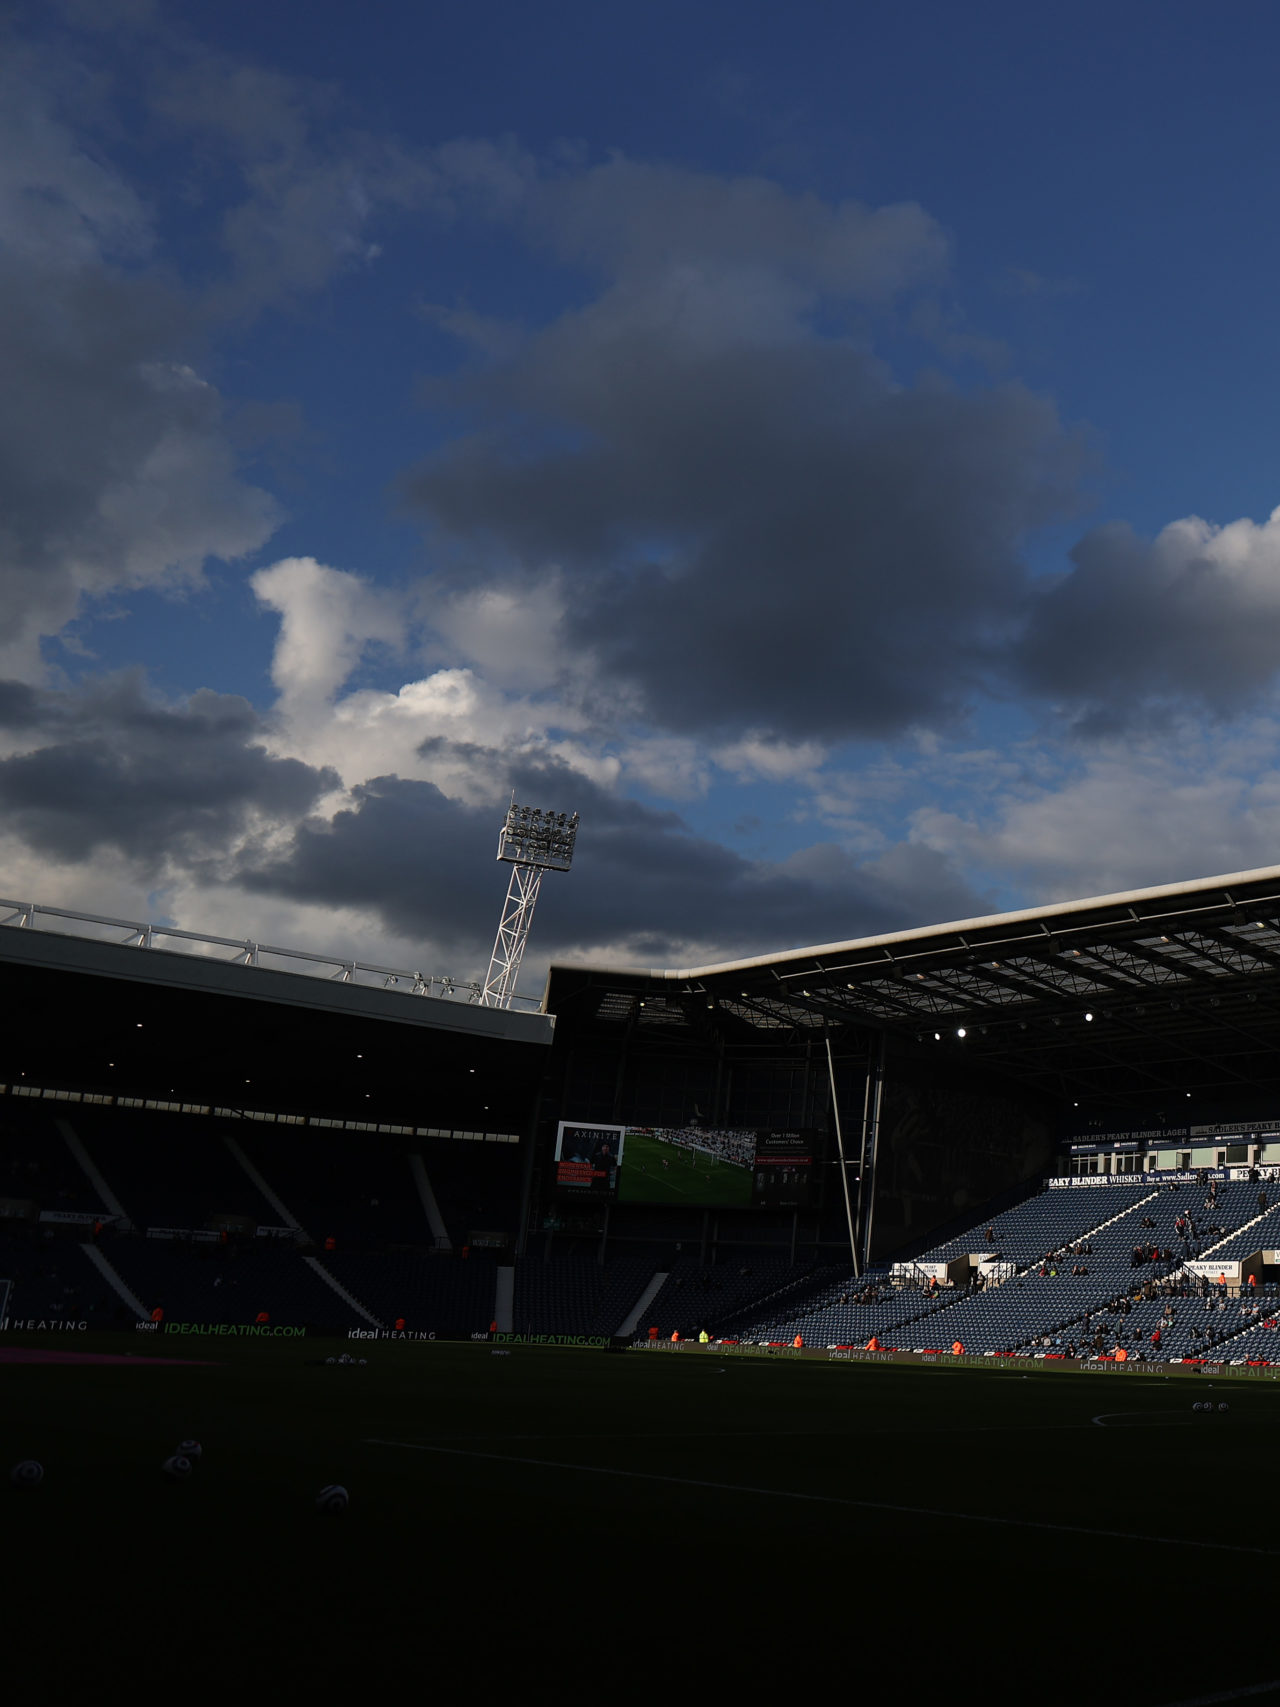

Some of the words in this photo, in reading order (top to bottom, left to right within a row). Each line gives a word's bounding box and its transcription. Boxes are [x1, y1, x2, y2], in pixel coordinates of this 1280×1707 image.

[1208, 1124, 1245, 1133] SADLER'S
[1247, 1122, 1272, 1131] PEAKY
[1074, 1134, 1106, 1142] SADLER'S
[1107, 1132, 1130, 1140] PEAKY
[1132, 1130, 1161, 1139] BLINDER
[1237, 1168, 1268, 1178] PEKY
[1042, 1177, 1070, 1186] PEAKY
[1072, 1176, 1108, 1185] BLINDER
[1110, 1174, 1142, 1183] WHISKEY
[14, 1320, 88, 1331] HEATING
[136, 1320, 158, 1330] ideal
[164, 1322, 306, 1336] IDEALHEATING.COM
[348, 1328, 379, 1339] ideal
[382, 1331, 436, 1340] HEATING
[471, 1332, 488, 1340] ideal
[492, 1333, 611, 1346] IDEALHEATING.COM
[651, 1341, 685, 1351] HEATING
[721, 1344, 801, 1356] IDEALHEATINGCOM
[830, 1350, 850, 1359] ideal
[852, 1352, 894, 1361] HEATING
[922, 1354, 937, 1362] ideal
[940, 1355, 1044, 1368] IDEALHEATINGCOM
[1080, 1360, 1107, 1371] ideal
[1110, 1363, 1163, 1373] HEATING
[1200, 1366, 1220, 1374] ideal
